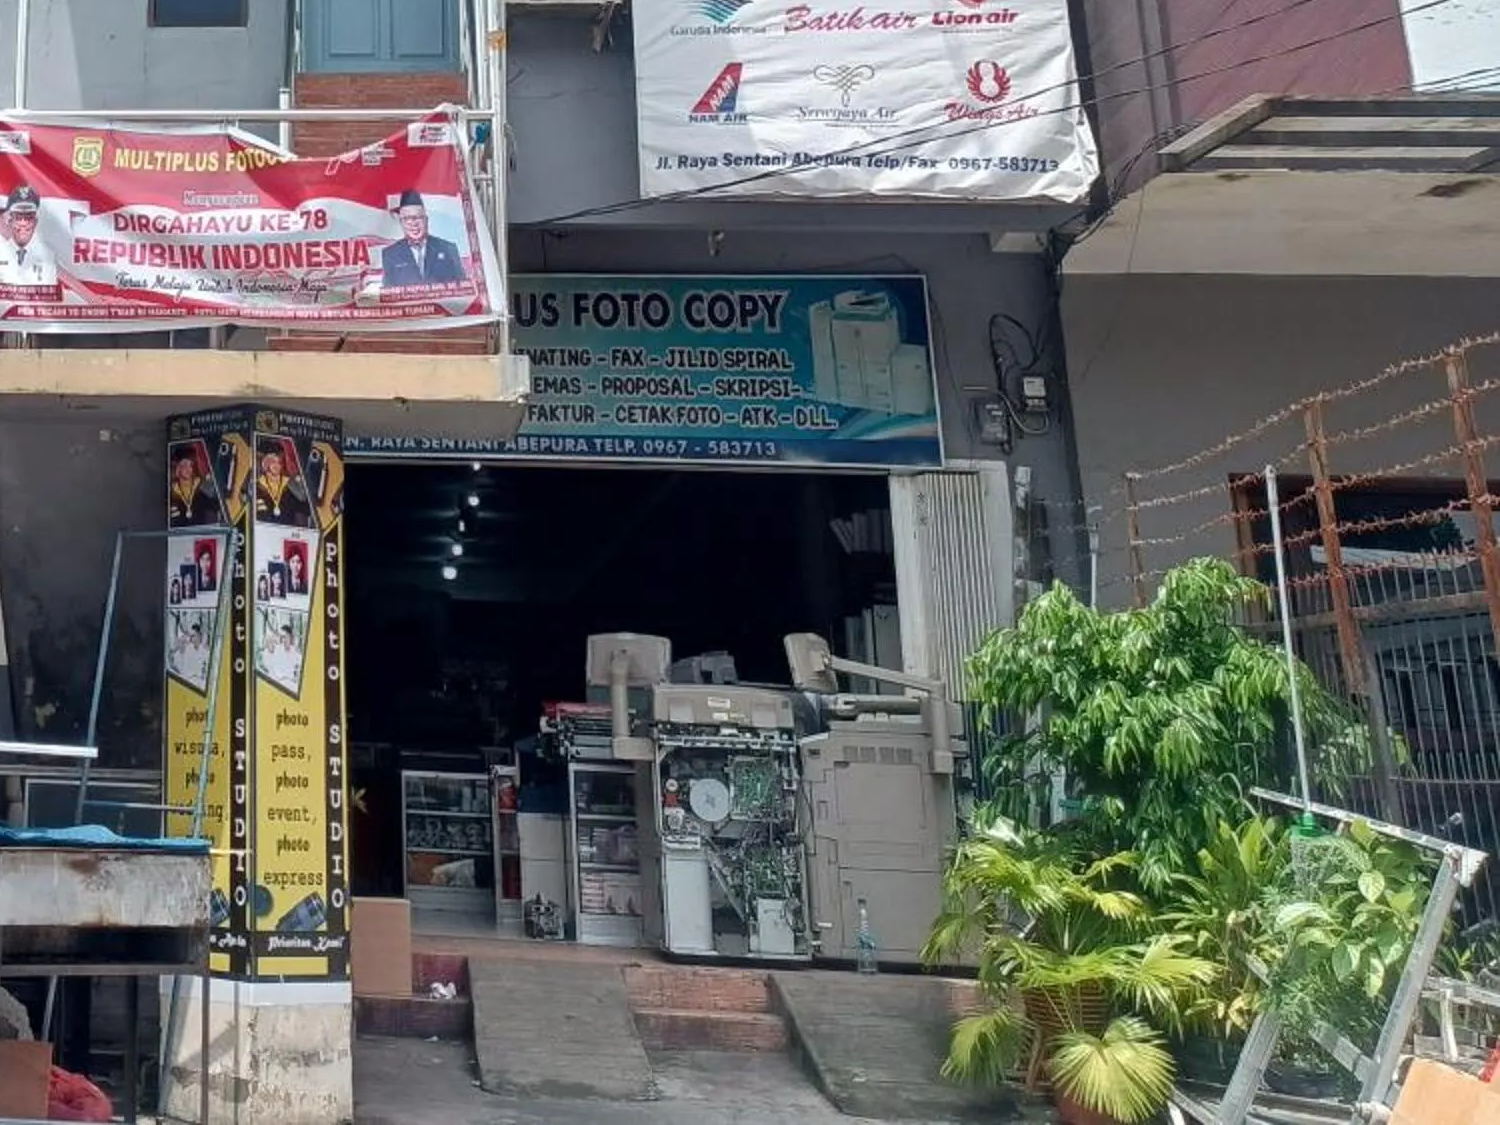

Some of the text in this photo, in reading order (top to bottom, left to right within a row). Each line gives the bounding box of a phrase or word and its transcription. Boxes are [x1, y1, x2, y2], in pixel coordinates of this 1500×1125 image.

[115, 148, 220, 172] MULTIPLUS
[677, 154, 718, 170] Raya
[722, 153, 787, 168] Sentani
[113, 208, 328, 235] DIRGAHAYU KE-78
[73, 238, 371, 270] REPUBLIK INDONESIA
[573, 292, 671, 328] FOTO
[684, 293, 784, 331] COPY
[611, 348, 643, 366] FAX
[665, 349, 718, 367] JILID
[723, 350, 793, 368] SPIRAL
[601, 377, 694, 396] PROPOSAL
[528, 405, 595, 423] FAKTUR
[615, 406, 672, 424] CETAK
[677, 406, 721, 424] FOTO
[741, 407, 776, 425] ATK
[504, 437, 589, 453] ABEPURA
[642, 440, 688, 455] 0967
[708, 440, 776, 456] 583713
[276, 707, 308, 729] photo
[276, 770, 309, 793] photo
[328, 725, 344, 909] STUDIO
[276, 835, 310, 857] photo
[263, 870, 323, 891] express
